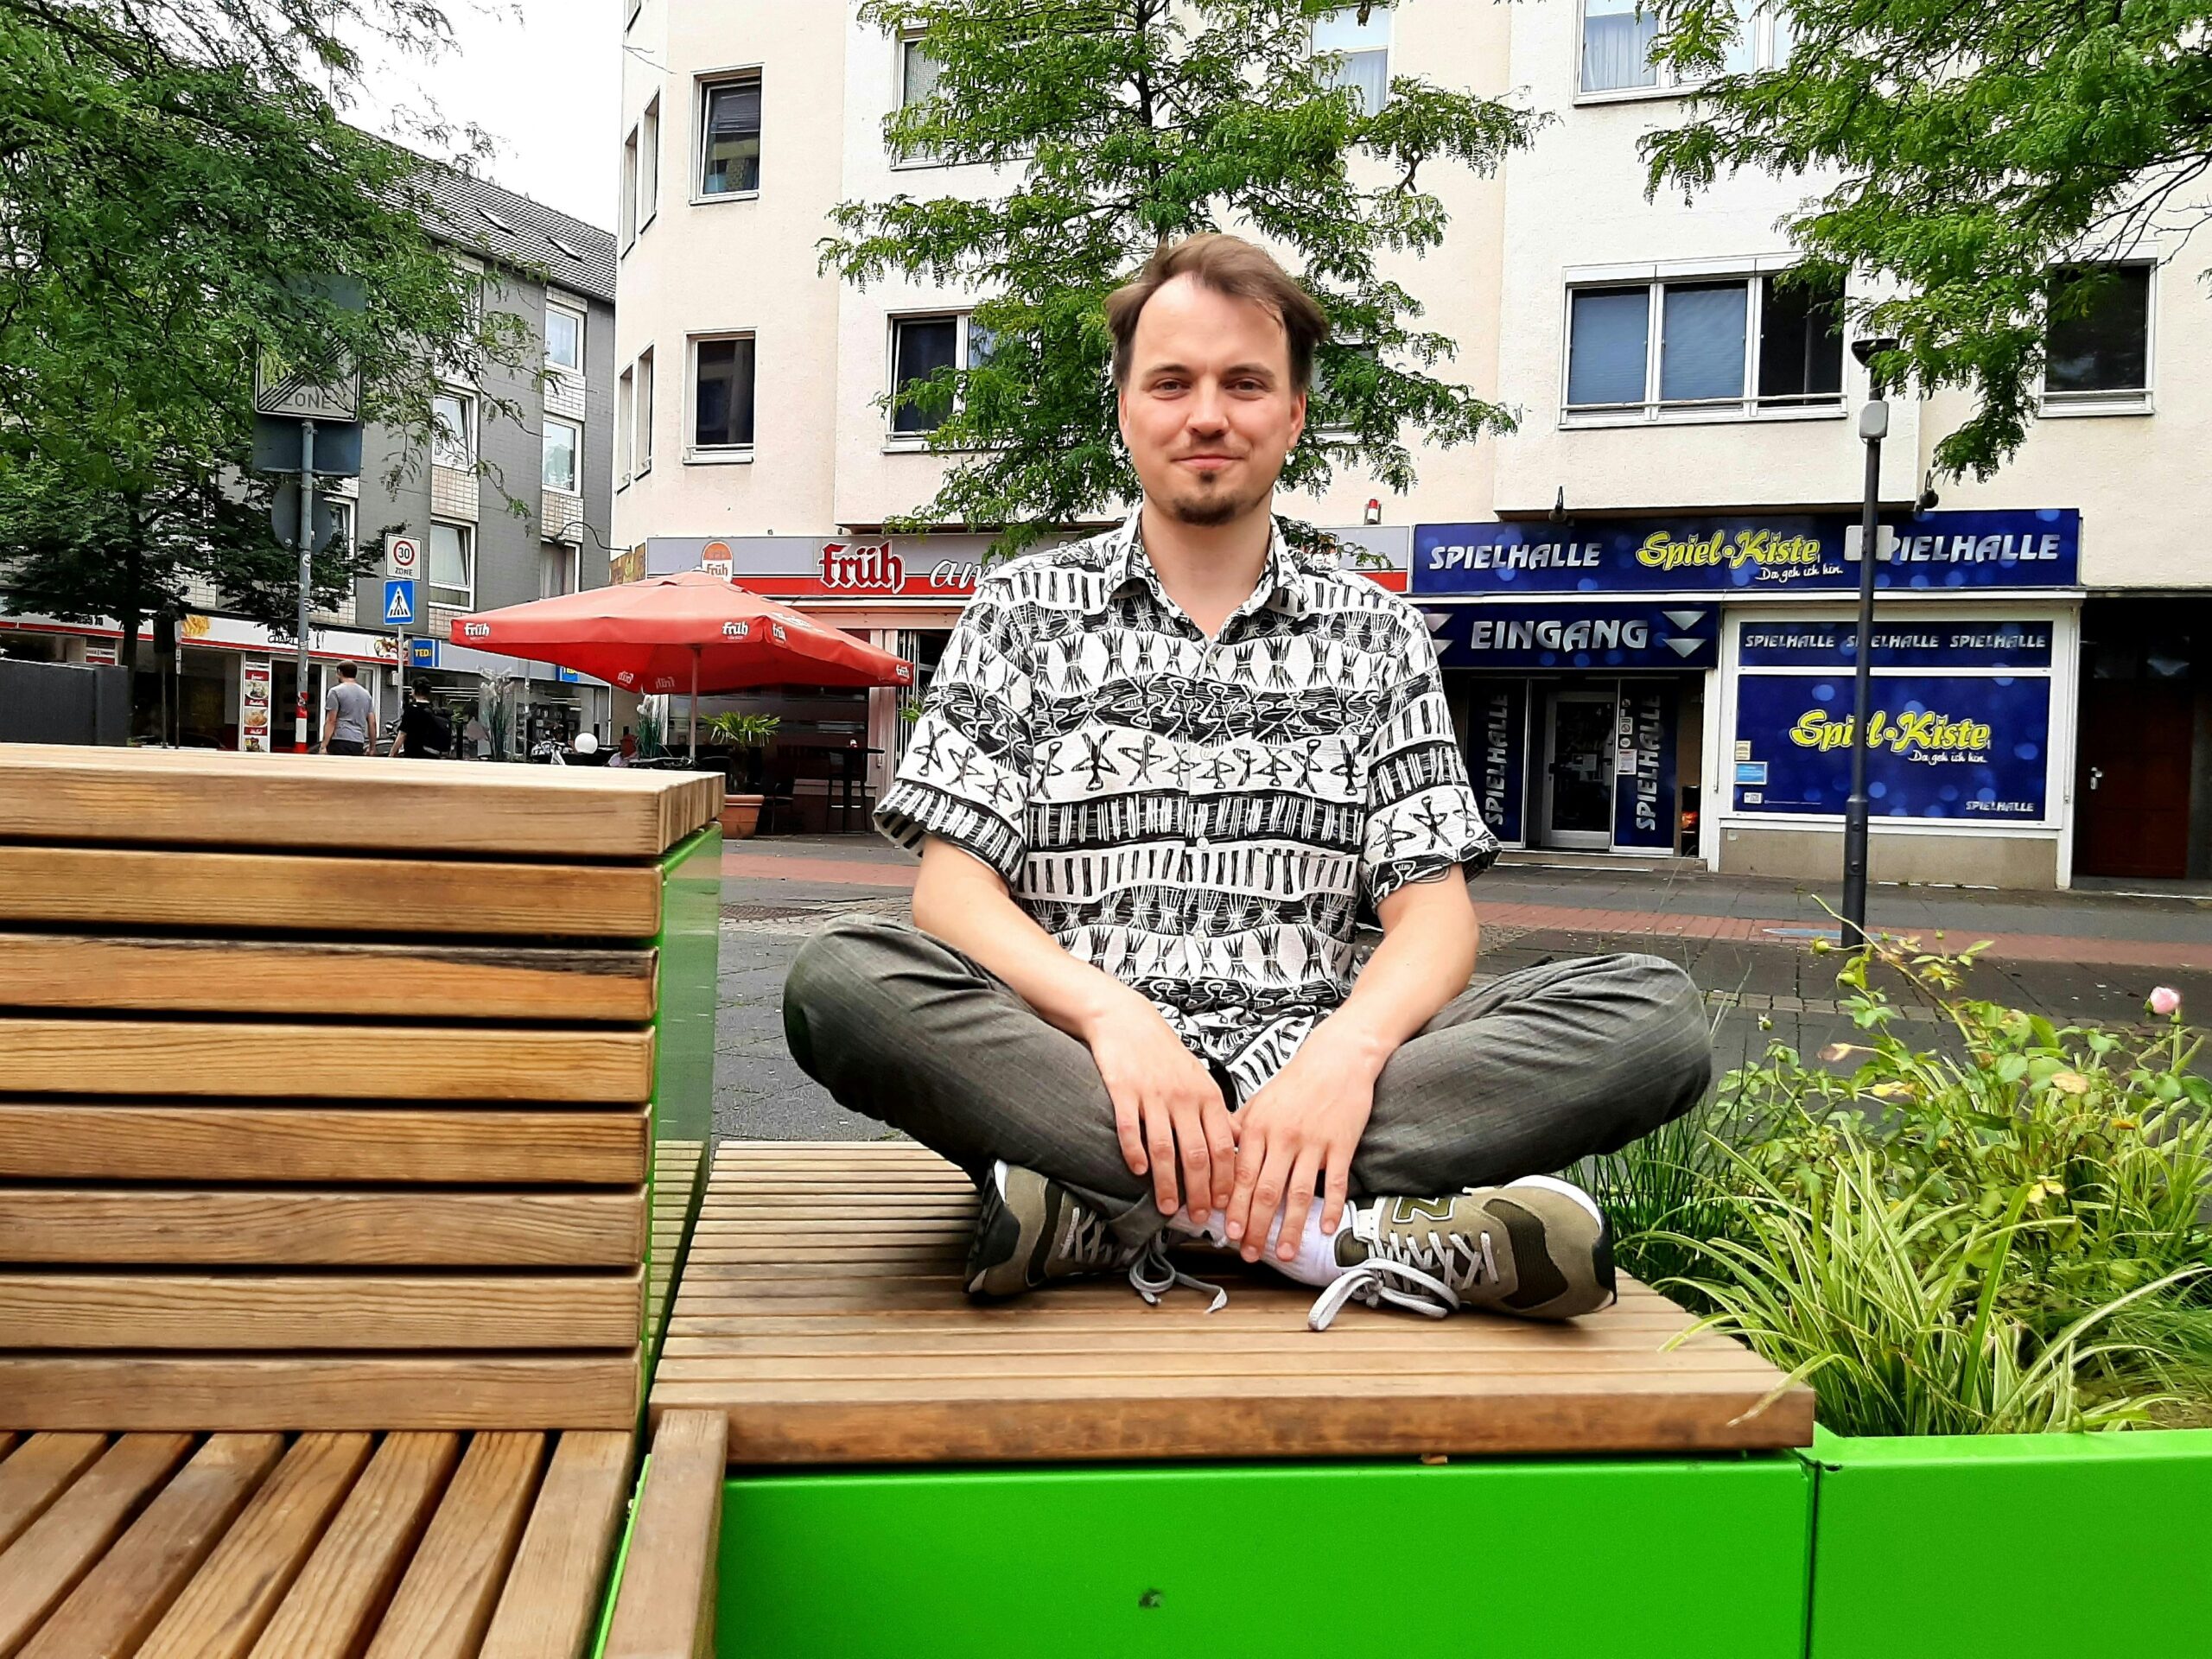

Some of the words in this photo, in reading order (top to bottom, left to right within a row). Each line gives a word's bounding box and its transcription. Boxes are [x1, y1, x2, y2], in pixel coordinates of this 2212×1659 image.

[398, 547, 410, 559] 30
[1429, 543, 1602, 570] SPIELHALLE
[1891, 534, 2061, 563] IELHALLE
[394, 567, 413, 577] ZONE
[1471, 620, 1648, 652] EINGANG
[1745, 635, 1836, 648] SPIELHALLE
[1846, 635, 1940, 648] SELHALLE
[1949, 635, 2046, 648] SPIELHALLE
[1484, 694, 1509, 825] SPIELHALLE
[1636, 695, 1661, 831] SPIELHALLE
[1966, 800, 2035, 812] SPIELHALLE
